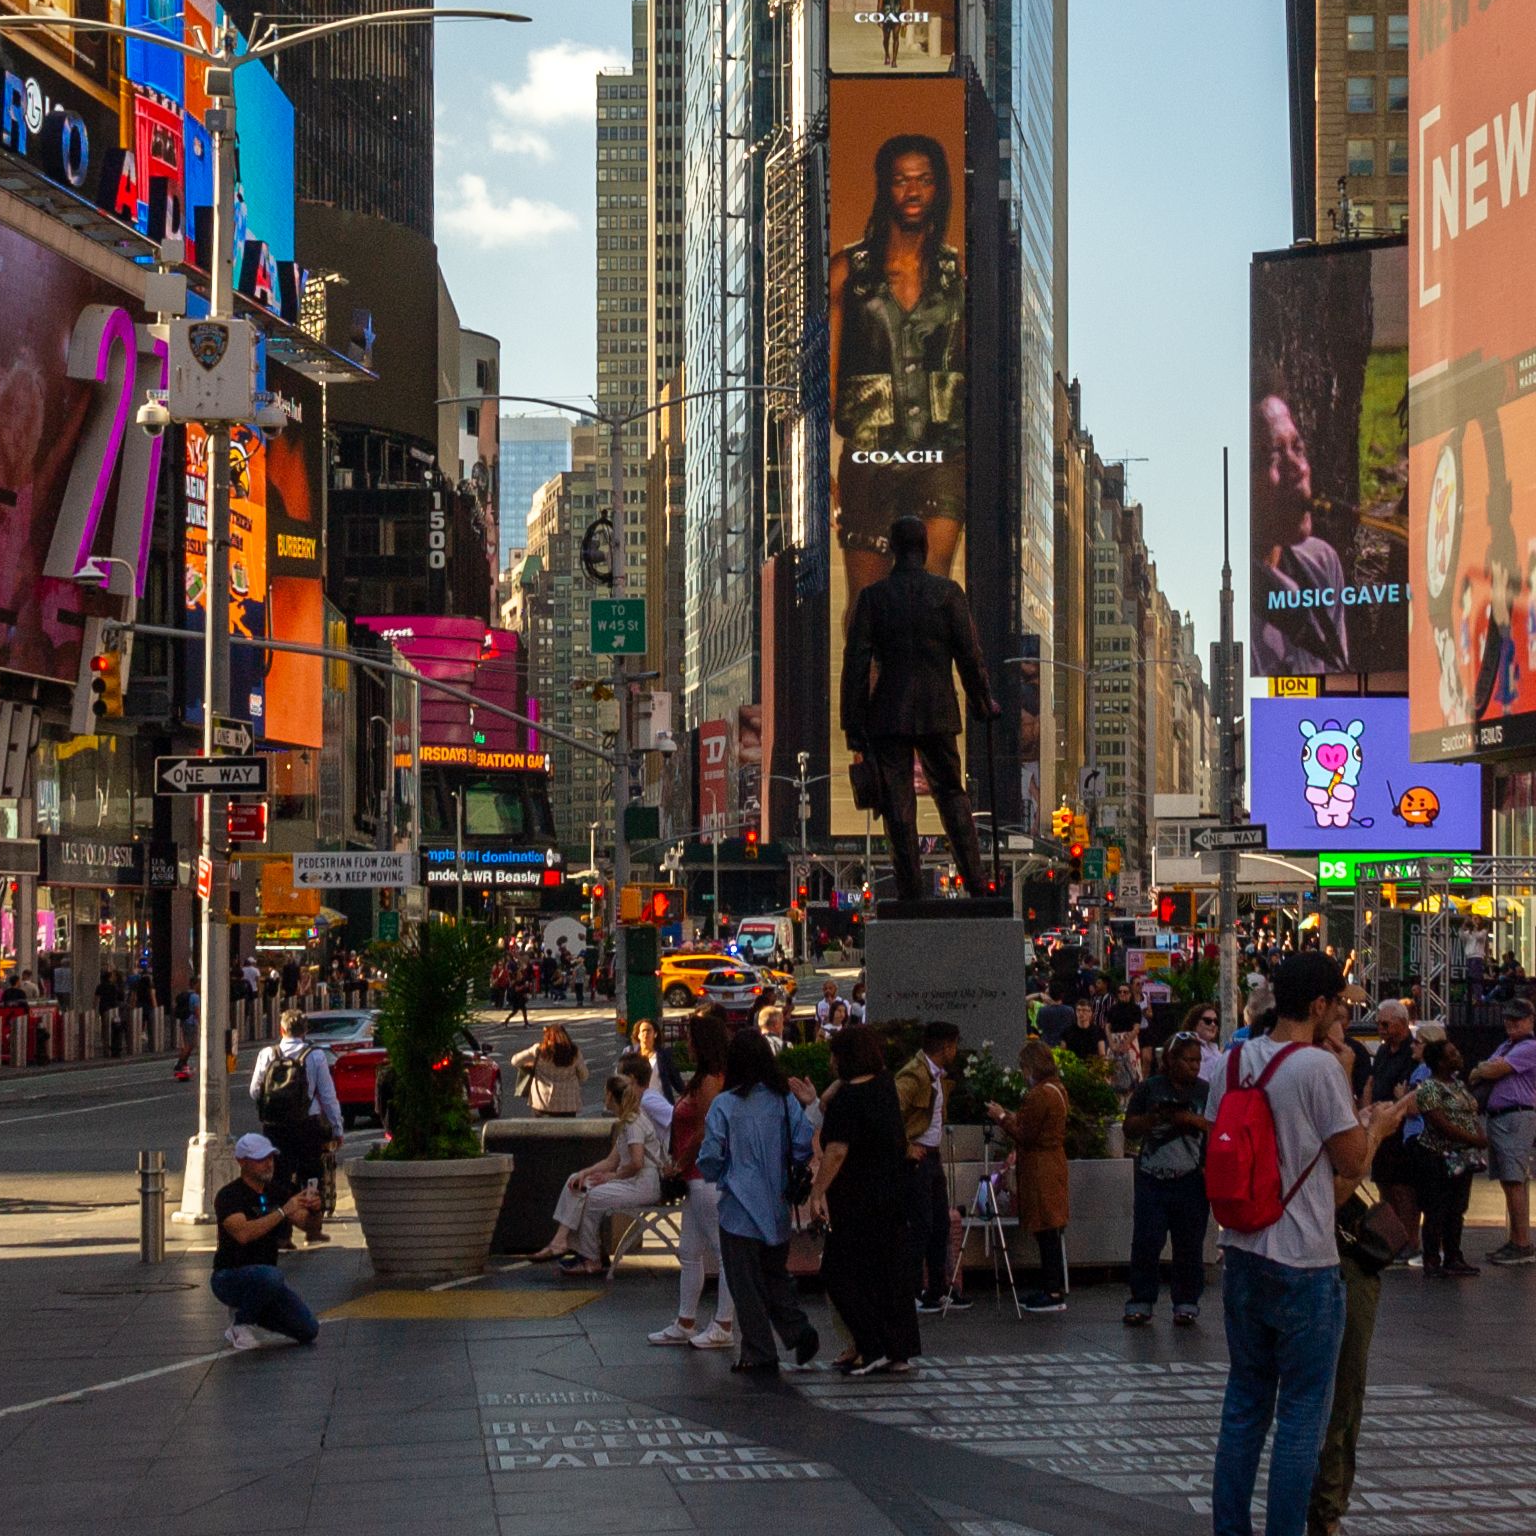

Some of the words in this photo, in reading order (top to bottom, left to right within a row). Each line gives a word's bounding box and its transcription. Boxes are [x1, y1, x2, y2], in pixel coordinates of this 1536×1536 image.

[852, 450, 943, 464] COACH
[429, 492, 445, 569] 1500
[277, 534, 316, 560] BURBERRY
[1268, 586, 1335, 610] MUSIC
[1340, 584, 1397, 606] GAVE
[612, 604, 624, 616] TO
[597, 620, 608, 632] W
[611, 620, 624, 632] 45
[627, 619, 639, 632] St
[216, 730, 230, 744] ONE
[235, 731, 248, 745] WAY
[173, 769, 204, 783] ONE
[219, 768, 252, 783] WAY
[1201, 834, 1223, 844] ONE
[1234, 832, 1258, 843] WAY
[298, 857, 351, 869] PEDESTRIAN
[355, 856, 378, 868] FLOW
[381, 855, 403, 867] ZONE
[345, 871, 367, 883] KEEP
[370, 869, 403, 882] MOVING
[489, 1417, 682, 1436] BELASCO
[494, 1430, 729, 1452] LYCEUM
[497, 1446, 777, 1472] PALACE
[675, 1461, 822, 1482] CORT
